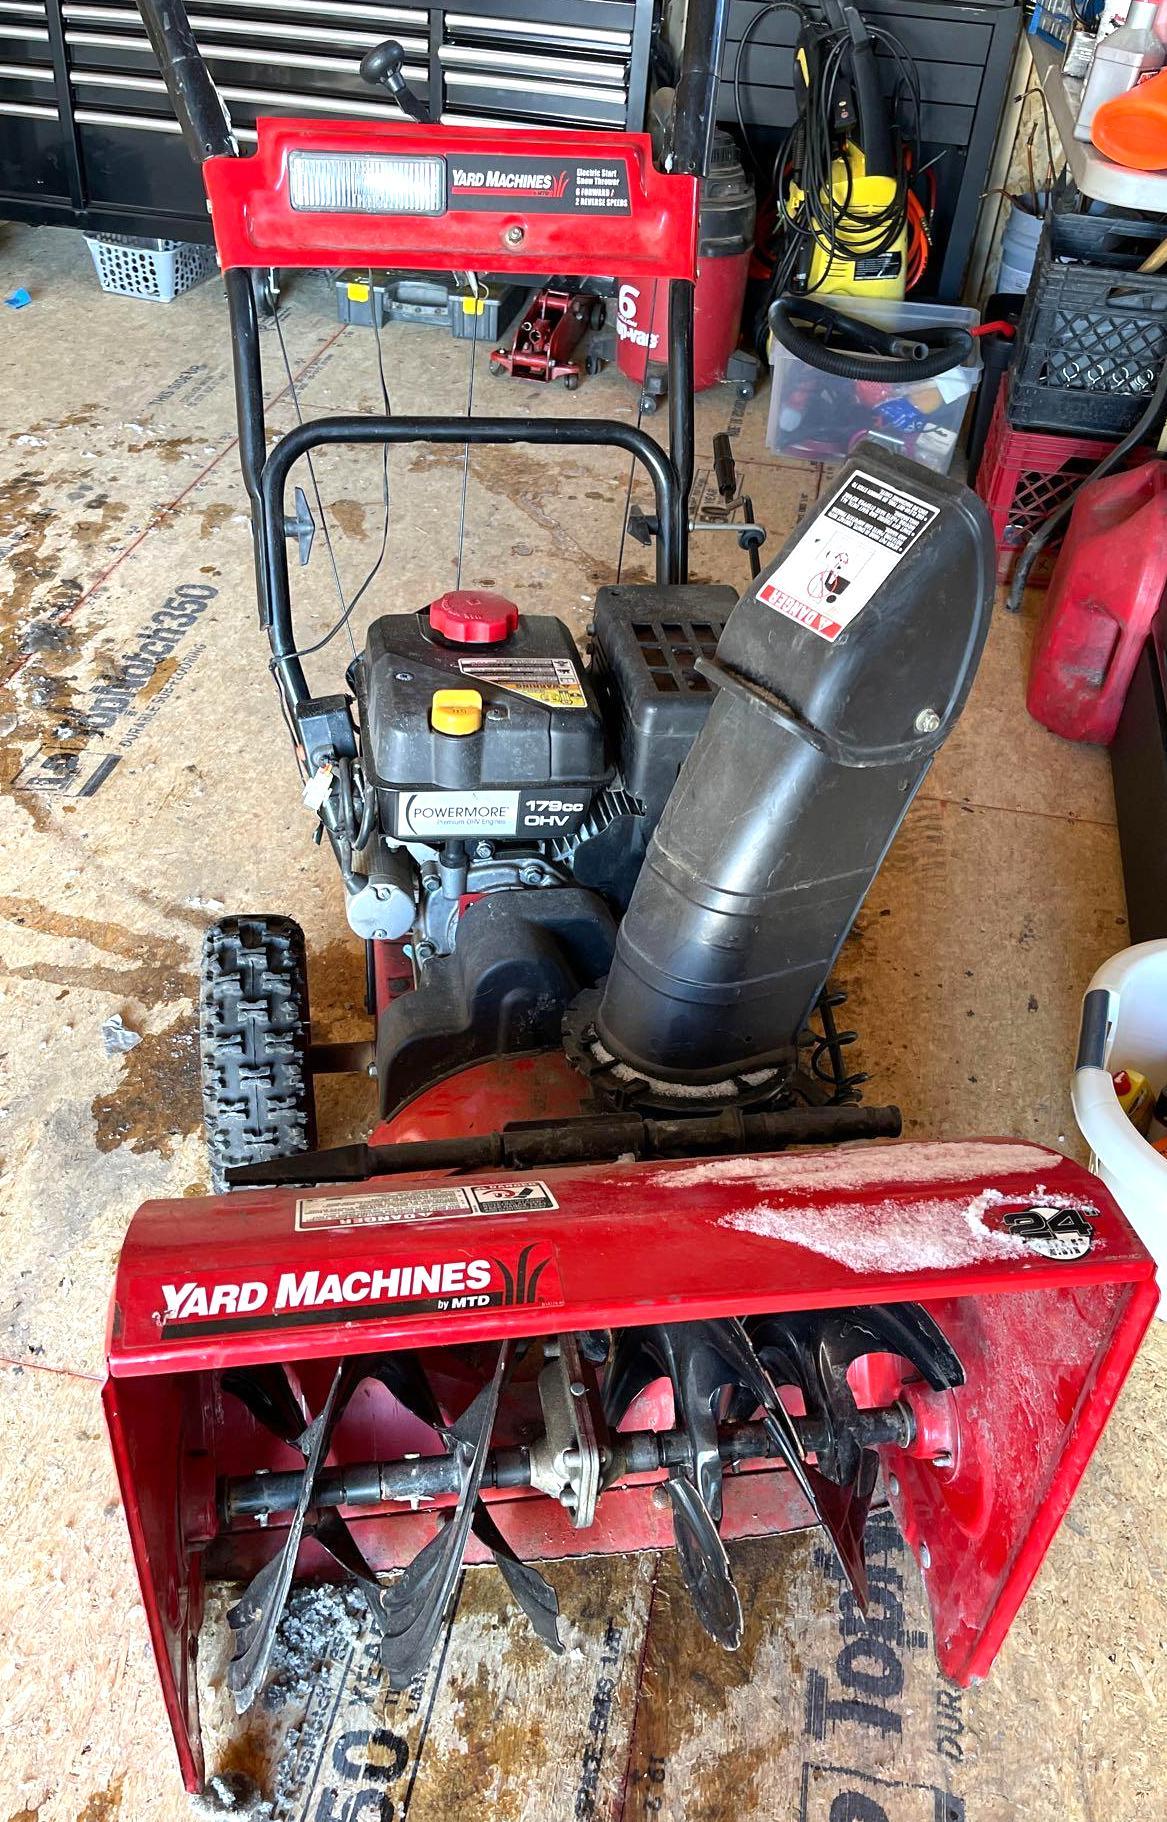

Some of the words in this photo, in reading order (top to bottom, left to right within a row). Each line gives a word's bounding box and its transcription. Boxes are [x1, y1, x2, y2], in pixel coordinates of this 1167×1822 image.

[576, 168, 601, 177] Electric
[601, 168, 618, 178] Start
[452, 169, 485, 187] YARD
[486, 170, 553, 190] MACHINES
[576, 176, 594, 185] Snow
[594, 176, 620, 186] Thrower
[575, 187, 581, 196] 6
[581, 187, 610, 197] FORWARD
[575, 197, 580, 206] 2
[580, 198, 606, 207] REVERSE
[606, 198, 628, 208] SPEEDS
[618, 284, 641, 319] 6
[149, 387, 172, 406] THIS
[168, 373, 192, 392] SIDE
[770, 587, 820, 632] DANGER
[119, 703, 161, 749] DURABLE
[413, 806, 506, 818] POWERMORE
[525, 800, 584, 812] 179cc
[436, 818, 465, 826] Premium
[481, 818, 506, 826] Engines
[524, 815, 570, 827] OHV
[339, 1212, 417, 1225] DANGER
[160, 1281, 268, 1320] YARD
[276, 1259, 492, 1309] MACHINES
[437, 1299, 450, 1311] by
[451, 1295, 491, 1308] MTD
